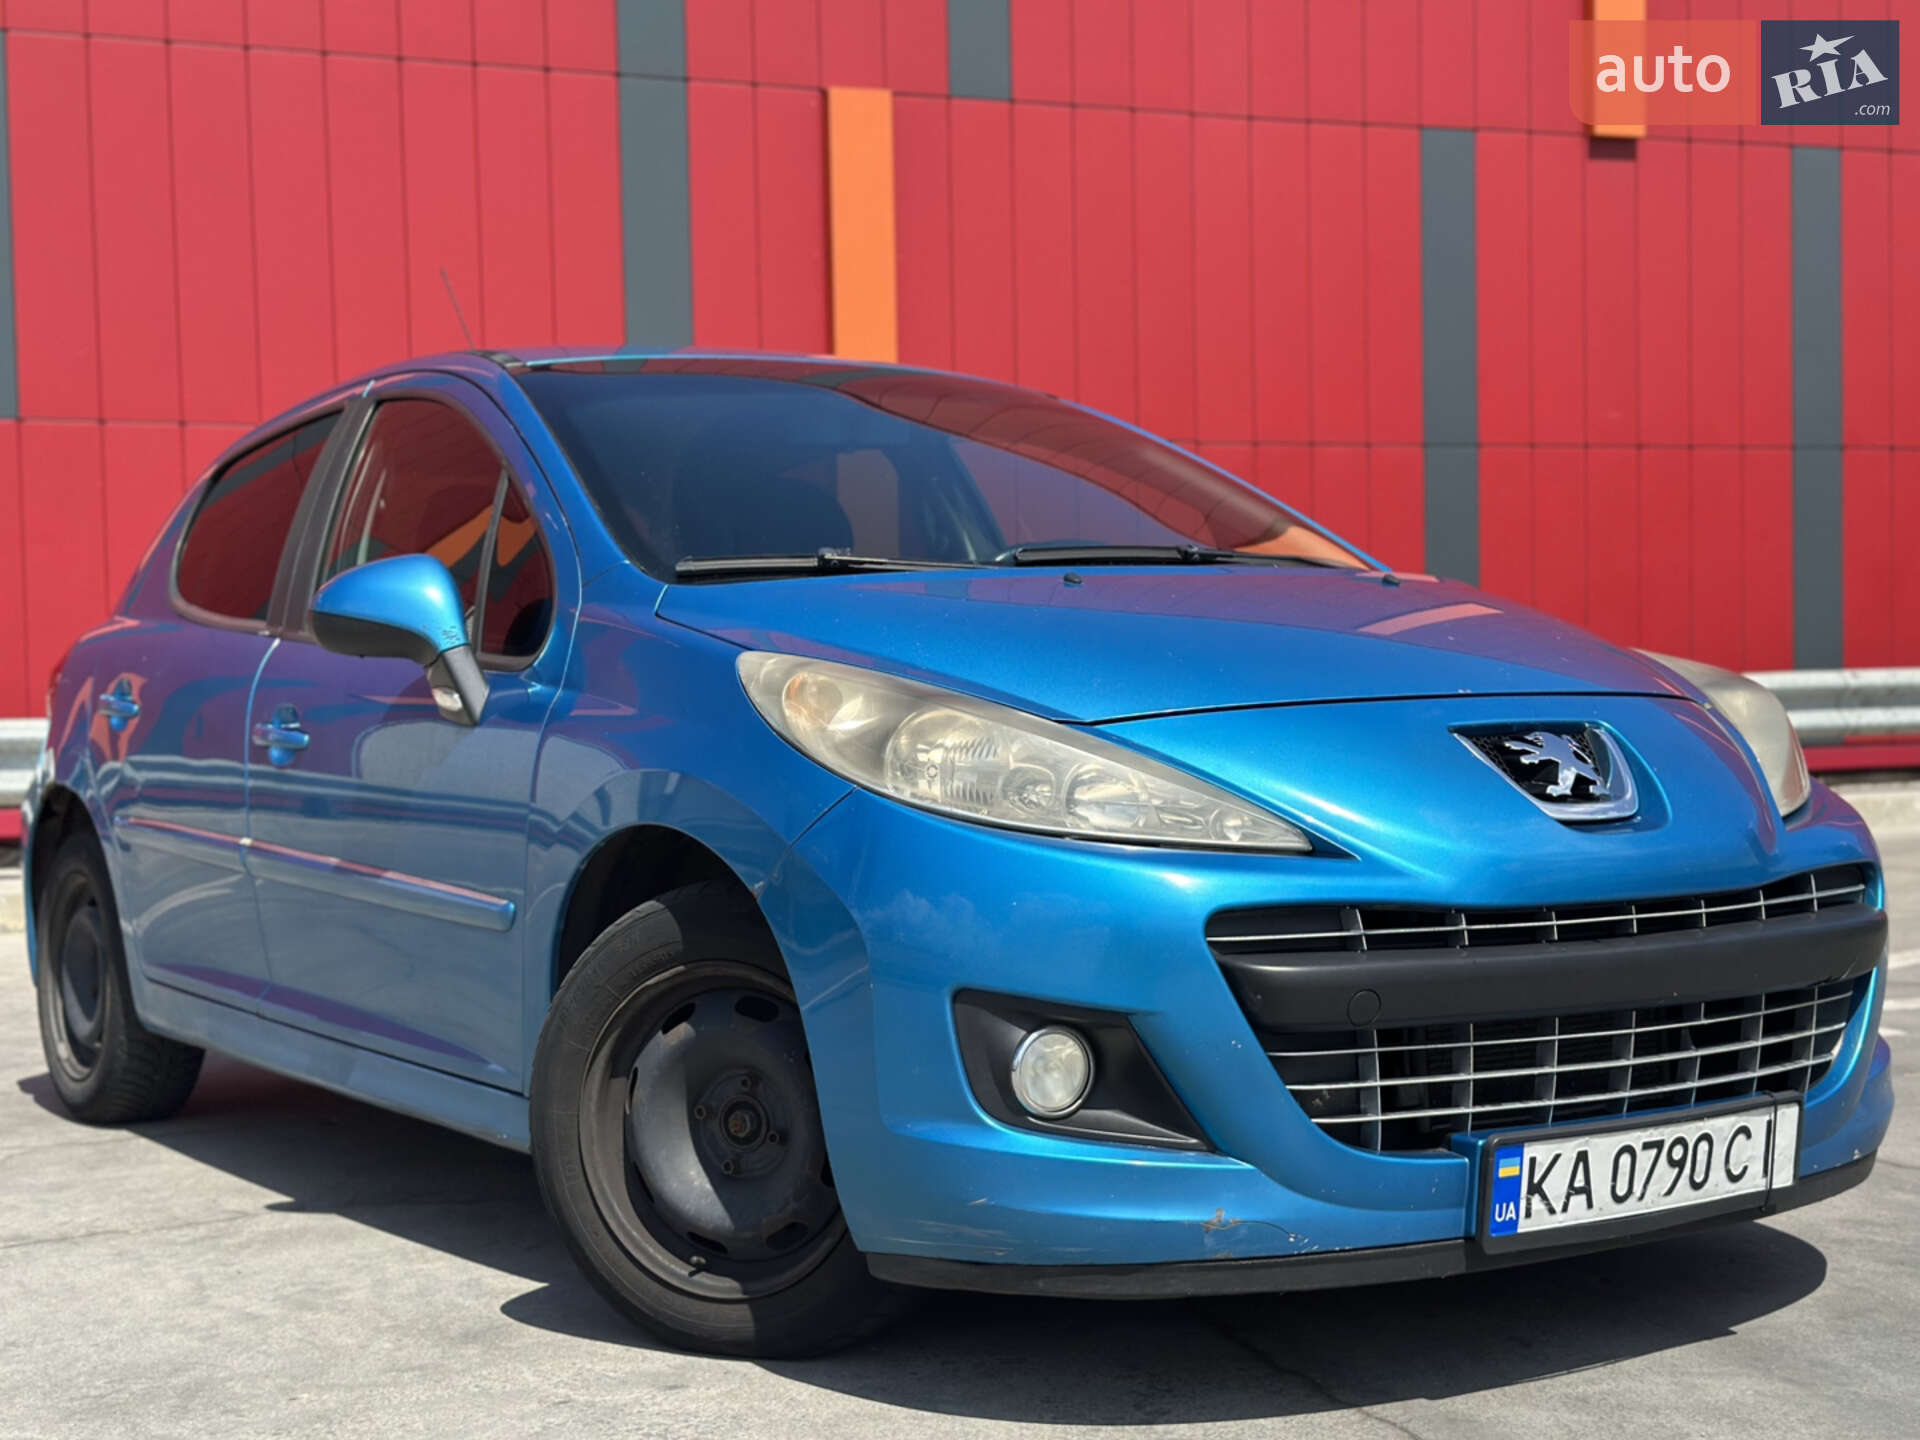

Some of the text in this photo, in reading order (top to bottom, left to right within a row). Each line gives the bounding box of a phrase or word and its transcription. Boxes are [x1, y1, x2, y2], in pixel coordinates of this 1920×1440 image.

[1525, 1150, 1593, 1219] KA
[1611, 1132, 1713, 1203] 0790
[1495, 1202, 1516, 1222] UA
